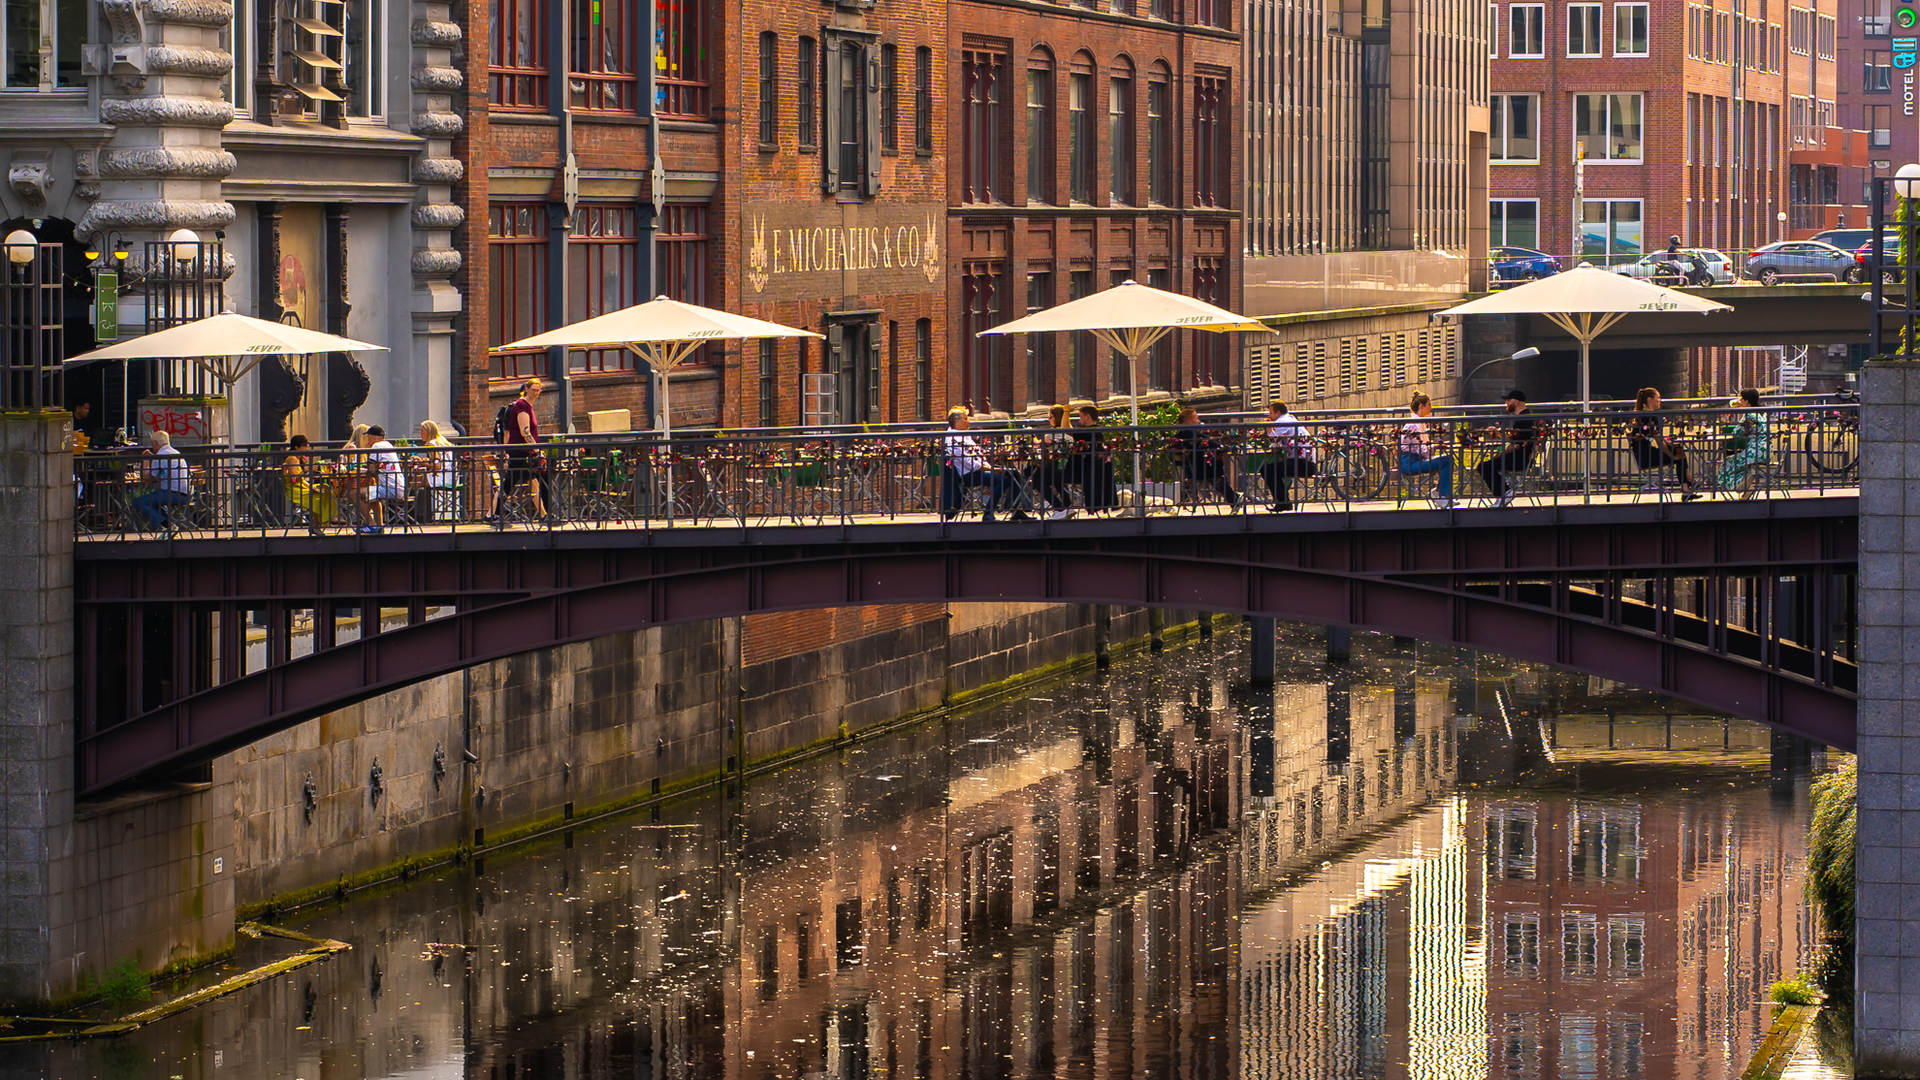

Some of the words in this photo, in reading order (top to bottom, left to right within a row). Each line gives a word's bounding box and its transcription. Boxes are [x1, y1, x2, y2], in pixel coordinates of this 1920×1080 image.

[773, 229, 786, 273] E.
[789, 226, 879, 272] MICHAELIS
[883, 226, 893, 268] &
[897, 225, 920, 267] CO
[1638, 302, 1678, 311] JEVER
[1175, 315, 1214, 324] JEVER
[687, 330, 724, 338] JEVER
[246, 344, 282, 353] JEVER
